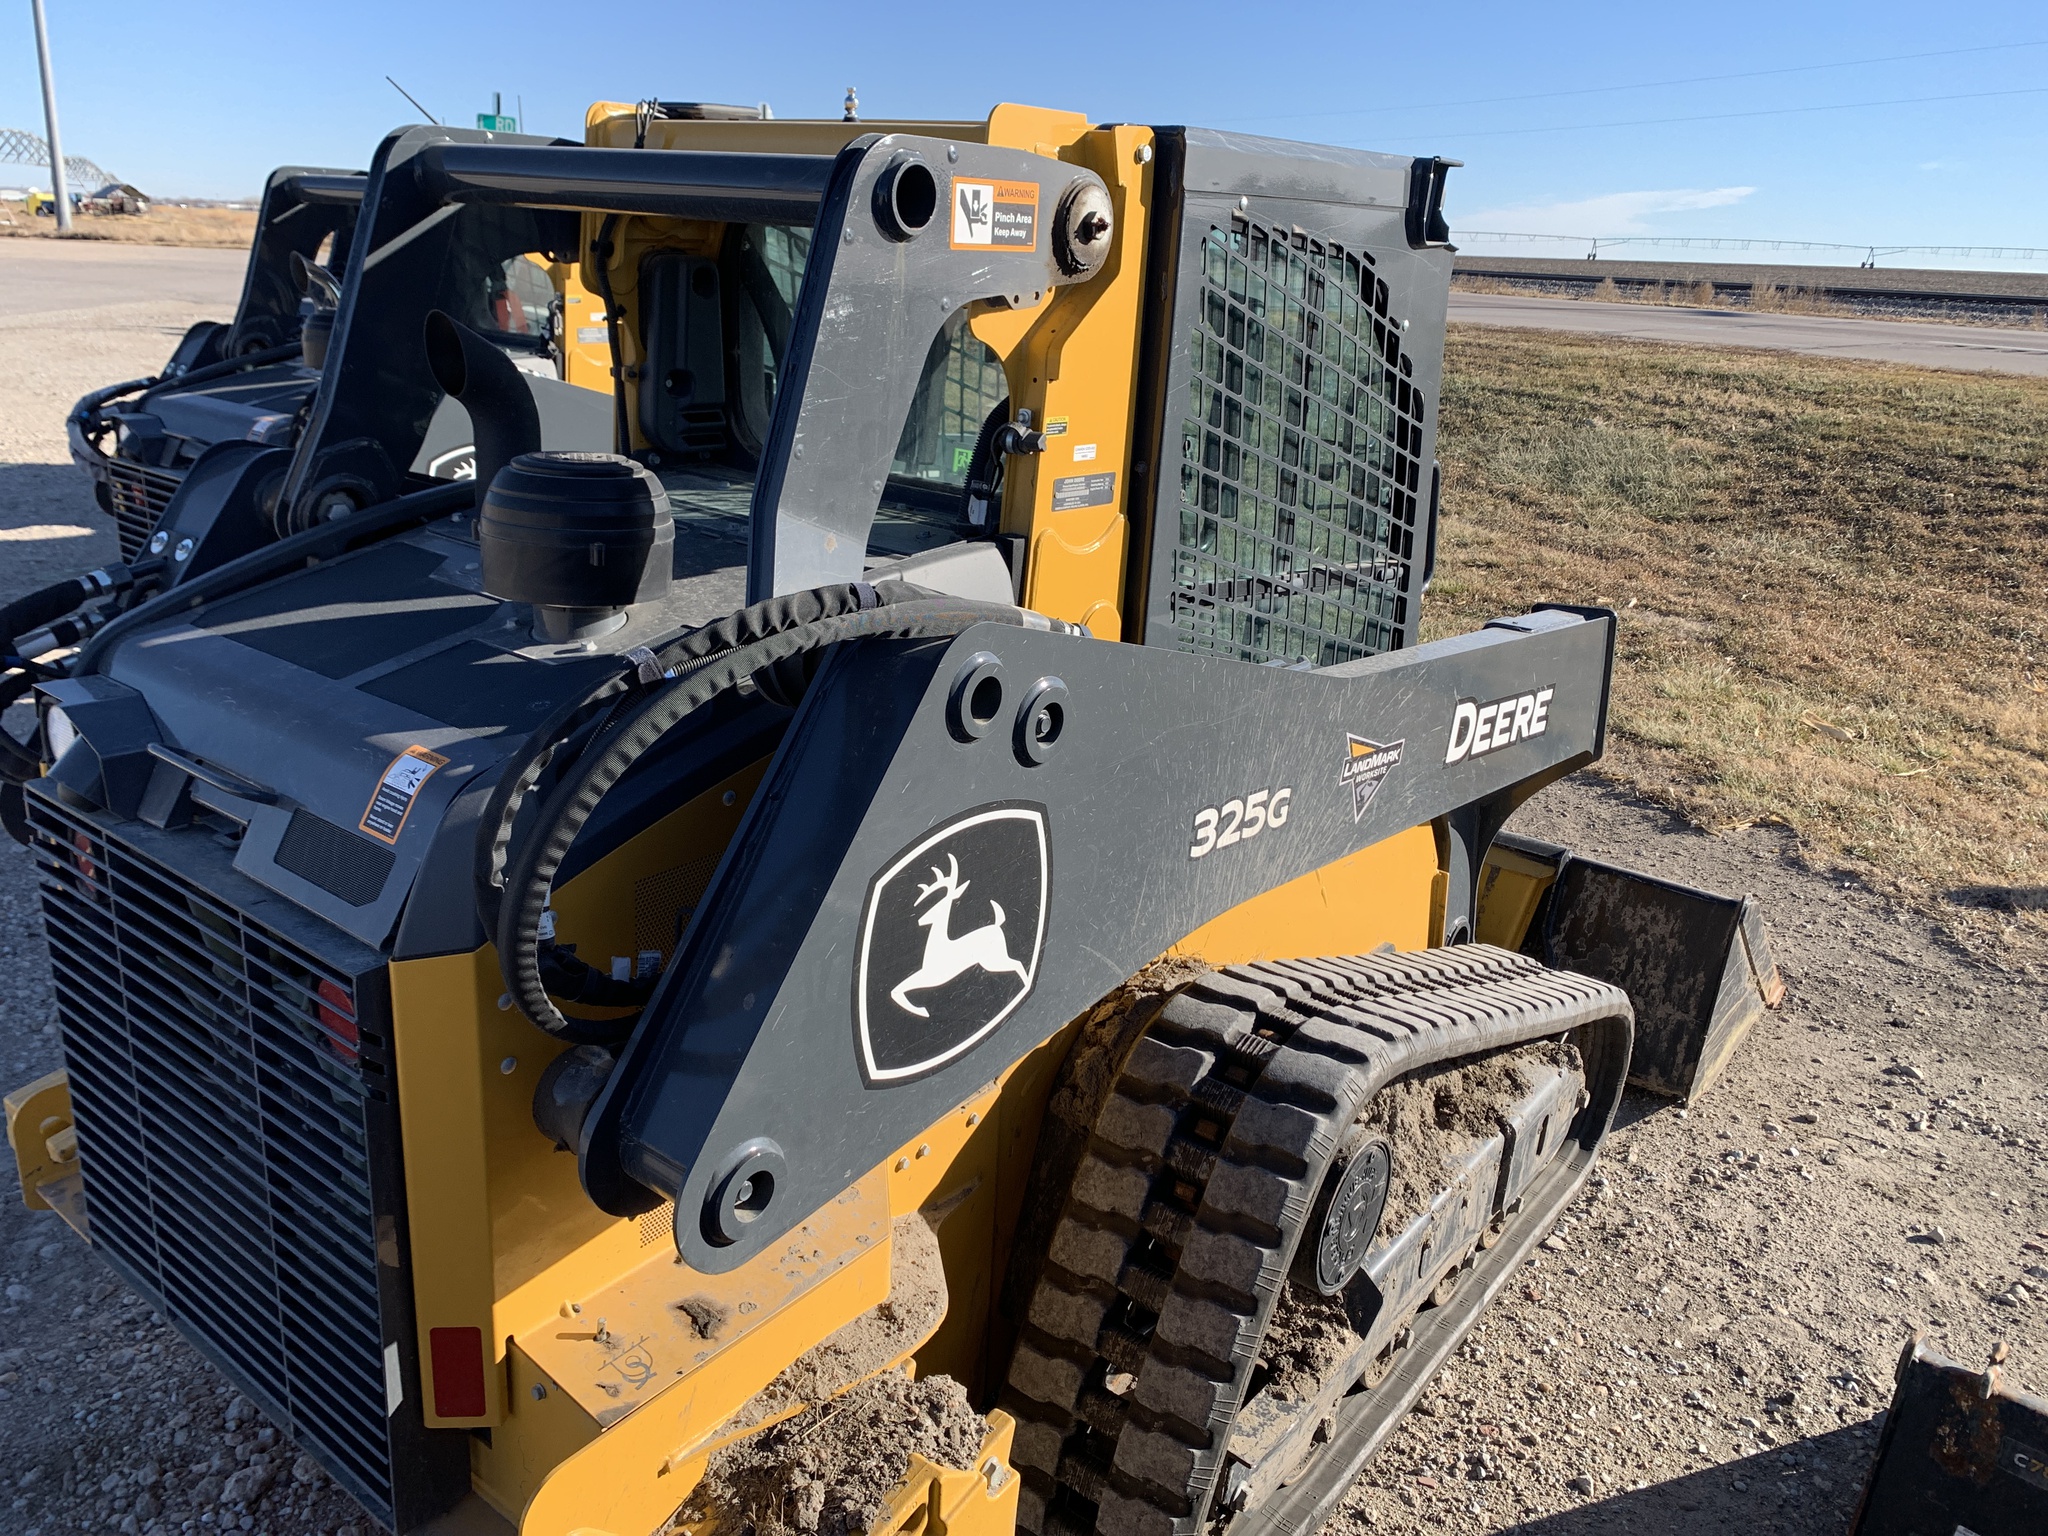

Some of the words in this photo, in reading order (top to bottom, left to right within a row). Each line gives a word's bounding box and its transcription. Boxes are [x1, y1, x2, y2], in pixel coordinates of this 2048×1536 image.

[496, 117, 514, 132] RD
[1003, 188, 1035, 199] WARNING
[995, 212, 1014, 223] Pinch
[1016, 213, 1032, 224] Area
[994, 227, 1010, 238] Keep
[1010, 228, 1027, 239] Away
[1445, 688, 1554, 764] DEERE
[1355, 765, 1388, 783] WORKSITE
[1189, 788, 1292, 858] 325G
